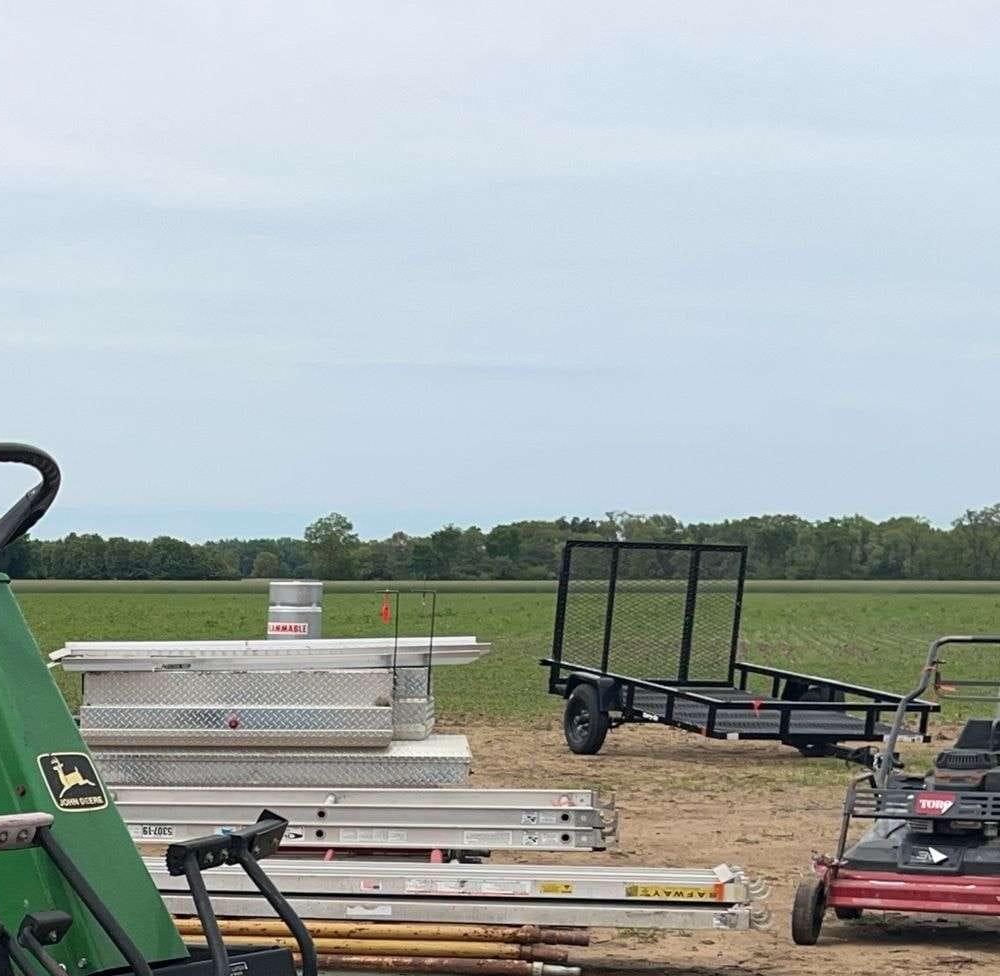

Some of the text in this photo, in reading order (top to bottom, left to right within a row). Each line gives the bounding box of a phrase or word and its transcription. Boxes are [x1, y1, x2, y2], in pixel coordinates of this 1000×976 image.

[60, 796, 104, 807] JOHN DEERE
[919, 799, 953, 811] TORO
